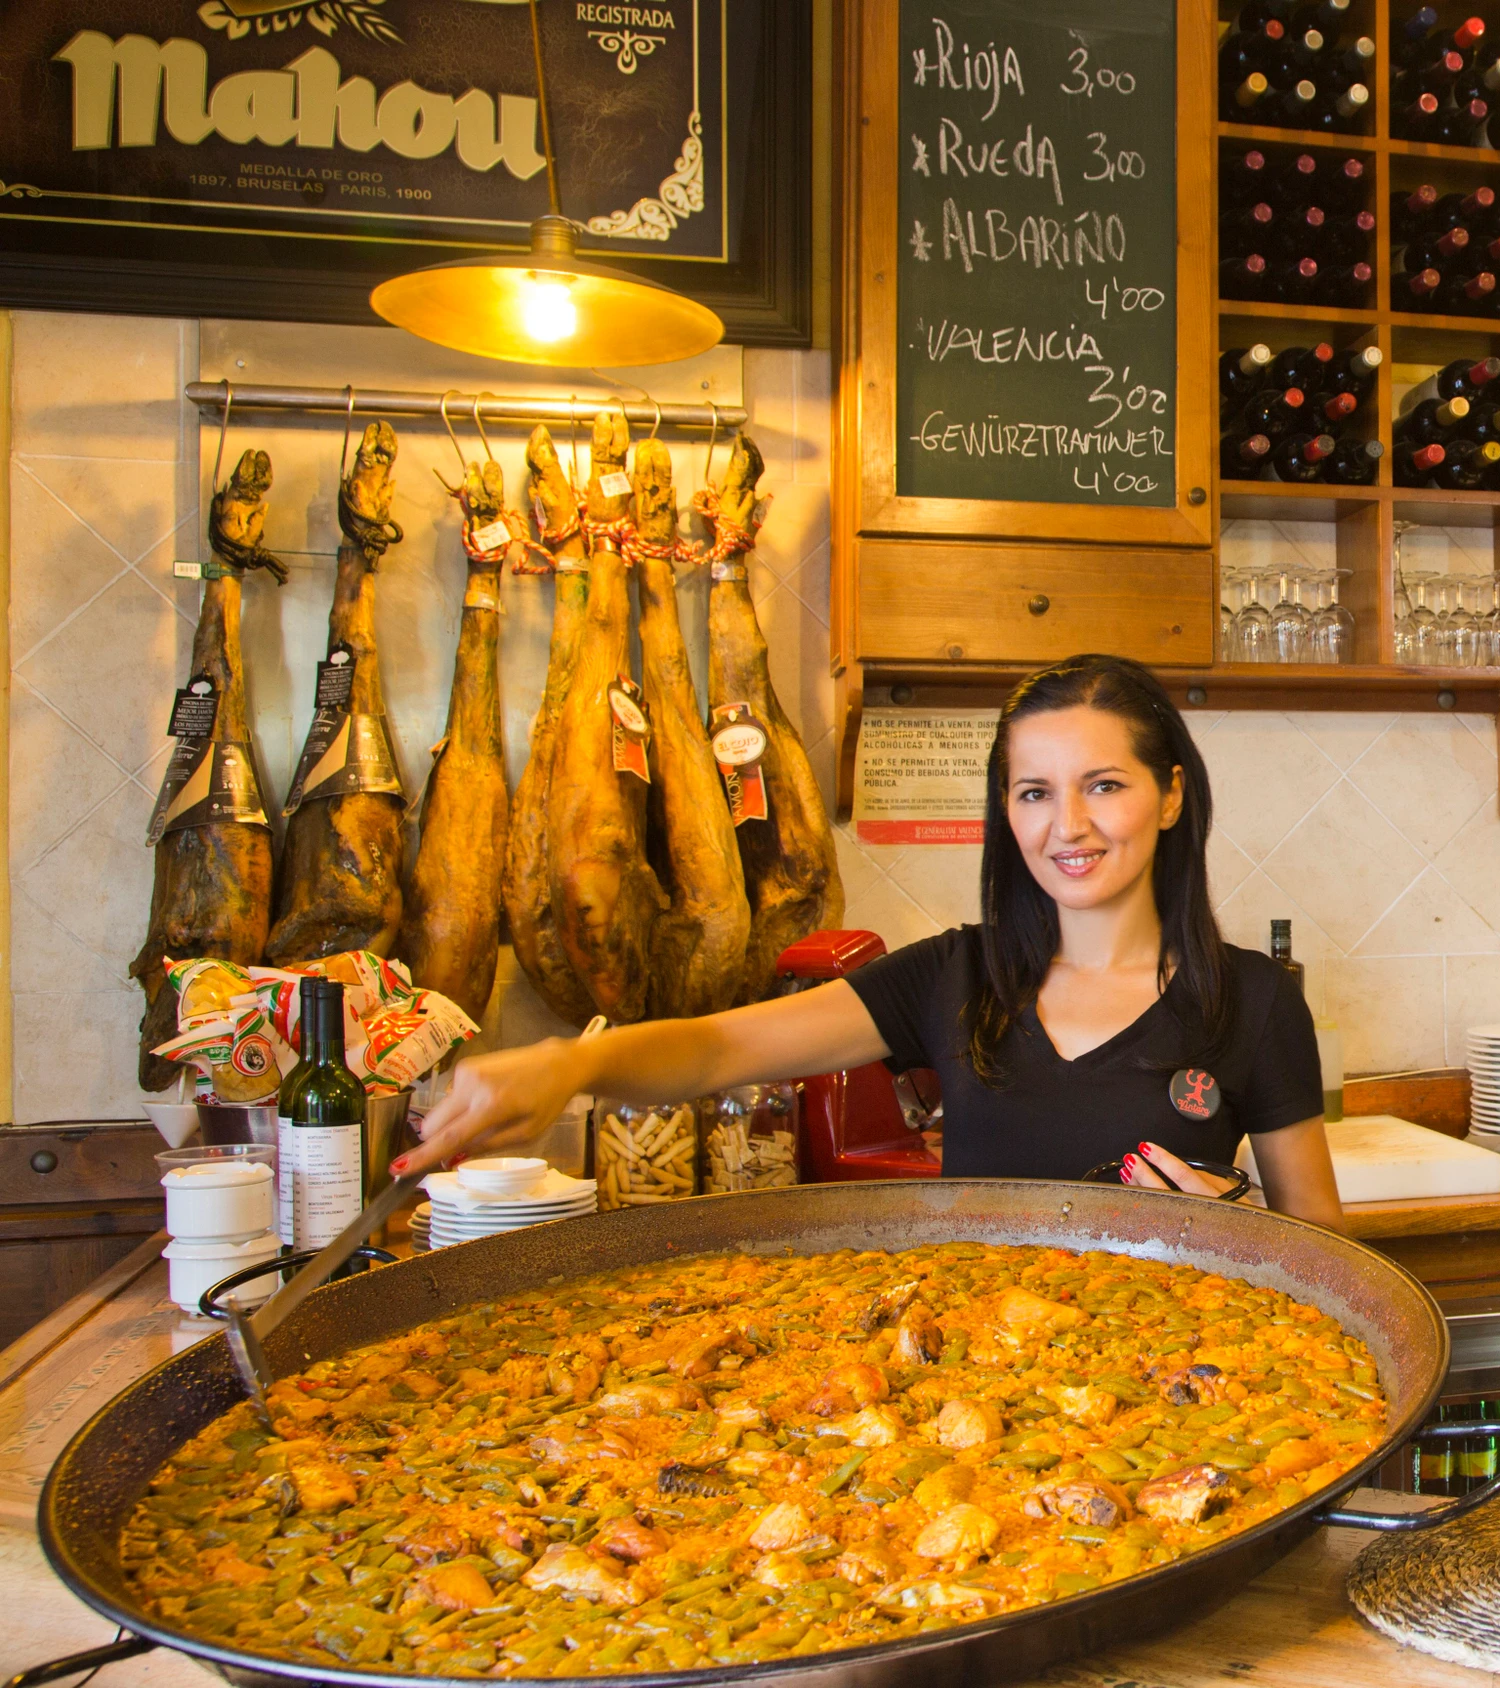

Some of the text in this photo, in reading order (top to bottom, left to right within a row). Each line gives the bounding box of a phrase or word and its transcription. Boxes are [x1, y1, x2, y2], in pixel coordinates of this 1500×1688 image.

[576, 3, 675, 29] REGISTRADA
[1060, 47, 1136, 98] 3,00
[50, 29, 555, 181] Mahou
[1083, 131, 1146, 183] 3,00
[239, 163, 383, 183] MEDALLA DE ORO
[189, 174, 433, 201] 1897, BRUSELAS PARIS, 1900
[864, 730, 993, 739] SUMINISTRO DE CUALQUIER TIPO
[871, 720, 882, 728] NO
[885, 720, 895, 728] SE
[897, 720, 932, 729] PERMITE
[935, 720, 945, 728] LA
[864, 740, 923, 749] ALCOHÓLICAS
[928, 741, 934, 749] A
[939, 741, 980, 749] MENORES
[864, 769, 903, 777] CONSUMO
[905, 769, 916, 777] DE
[917, 769, 950, 777] BEBIDAS
[872, 759, 883, 767] NO
[887, 759, 897, 767] SE
[900, 759, 936, 767] PERMITE
[939, 759, 949, 767] LA
